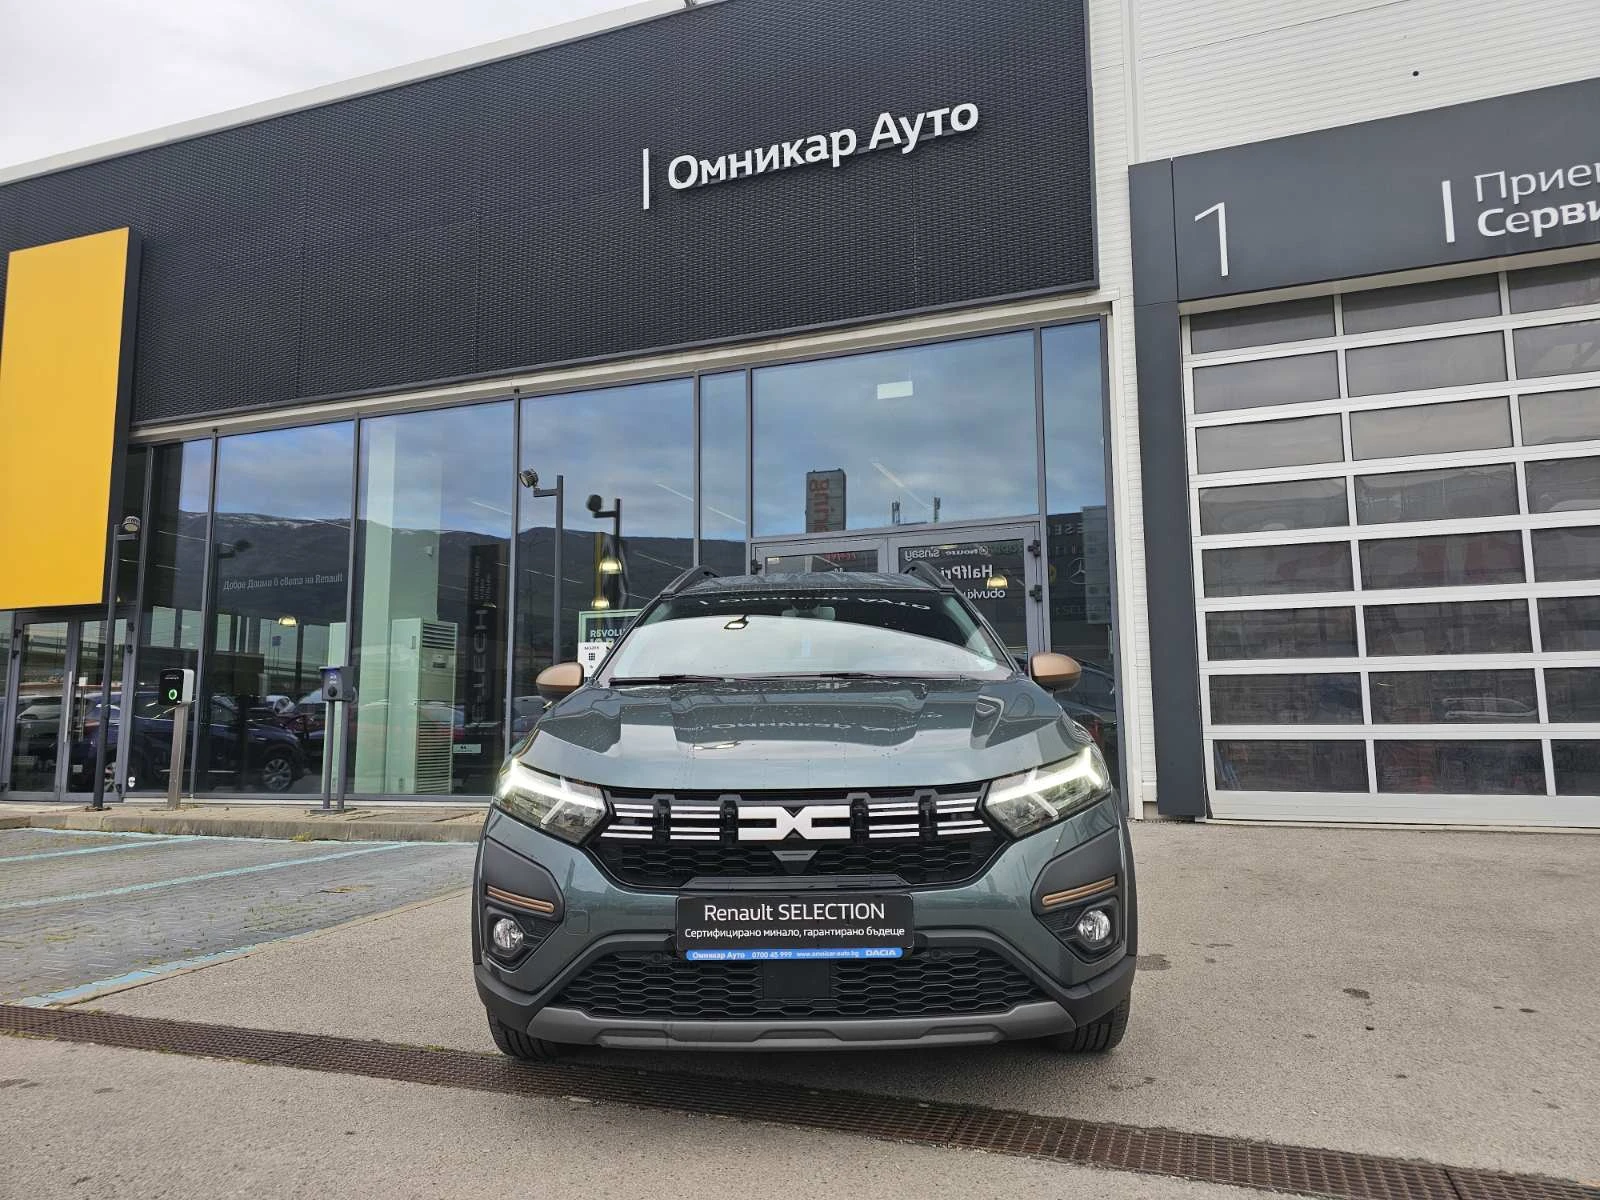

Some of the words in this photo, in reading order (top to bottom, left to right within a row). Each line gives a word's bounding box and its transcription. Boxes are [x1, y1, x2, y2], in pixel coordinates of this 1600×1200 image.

[668, 128, 857, 190] Омникар
[868, 102, 979, 155] Ауто
[1474, 162, 1600, 205] Прие
[1194, 201, 1229, 277] 1
[704, 903, 774, 922] Renault
[778, 903, 885, 921] SELECTION
[684, 928, 762, 940] Сертифицирано
[763, 928, 801, 938] минало,
[803, 927, 865, 939] гарантирано
[866, 926, 905, 937] бъдеще
[692, 951, 726, 961] Омникар
[727, 951, 745, 960] Ауто
[752, 951, 769, 959] 0700
[865, 948, 896, 957] DACIA
